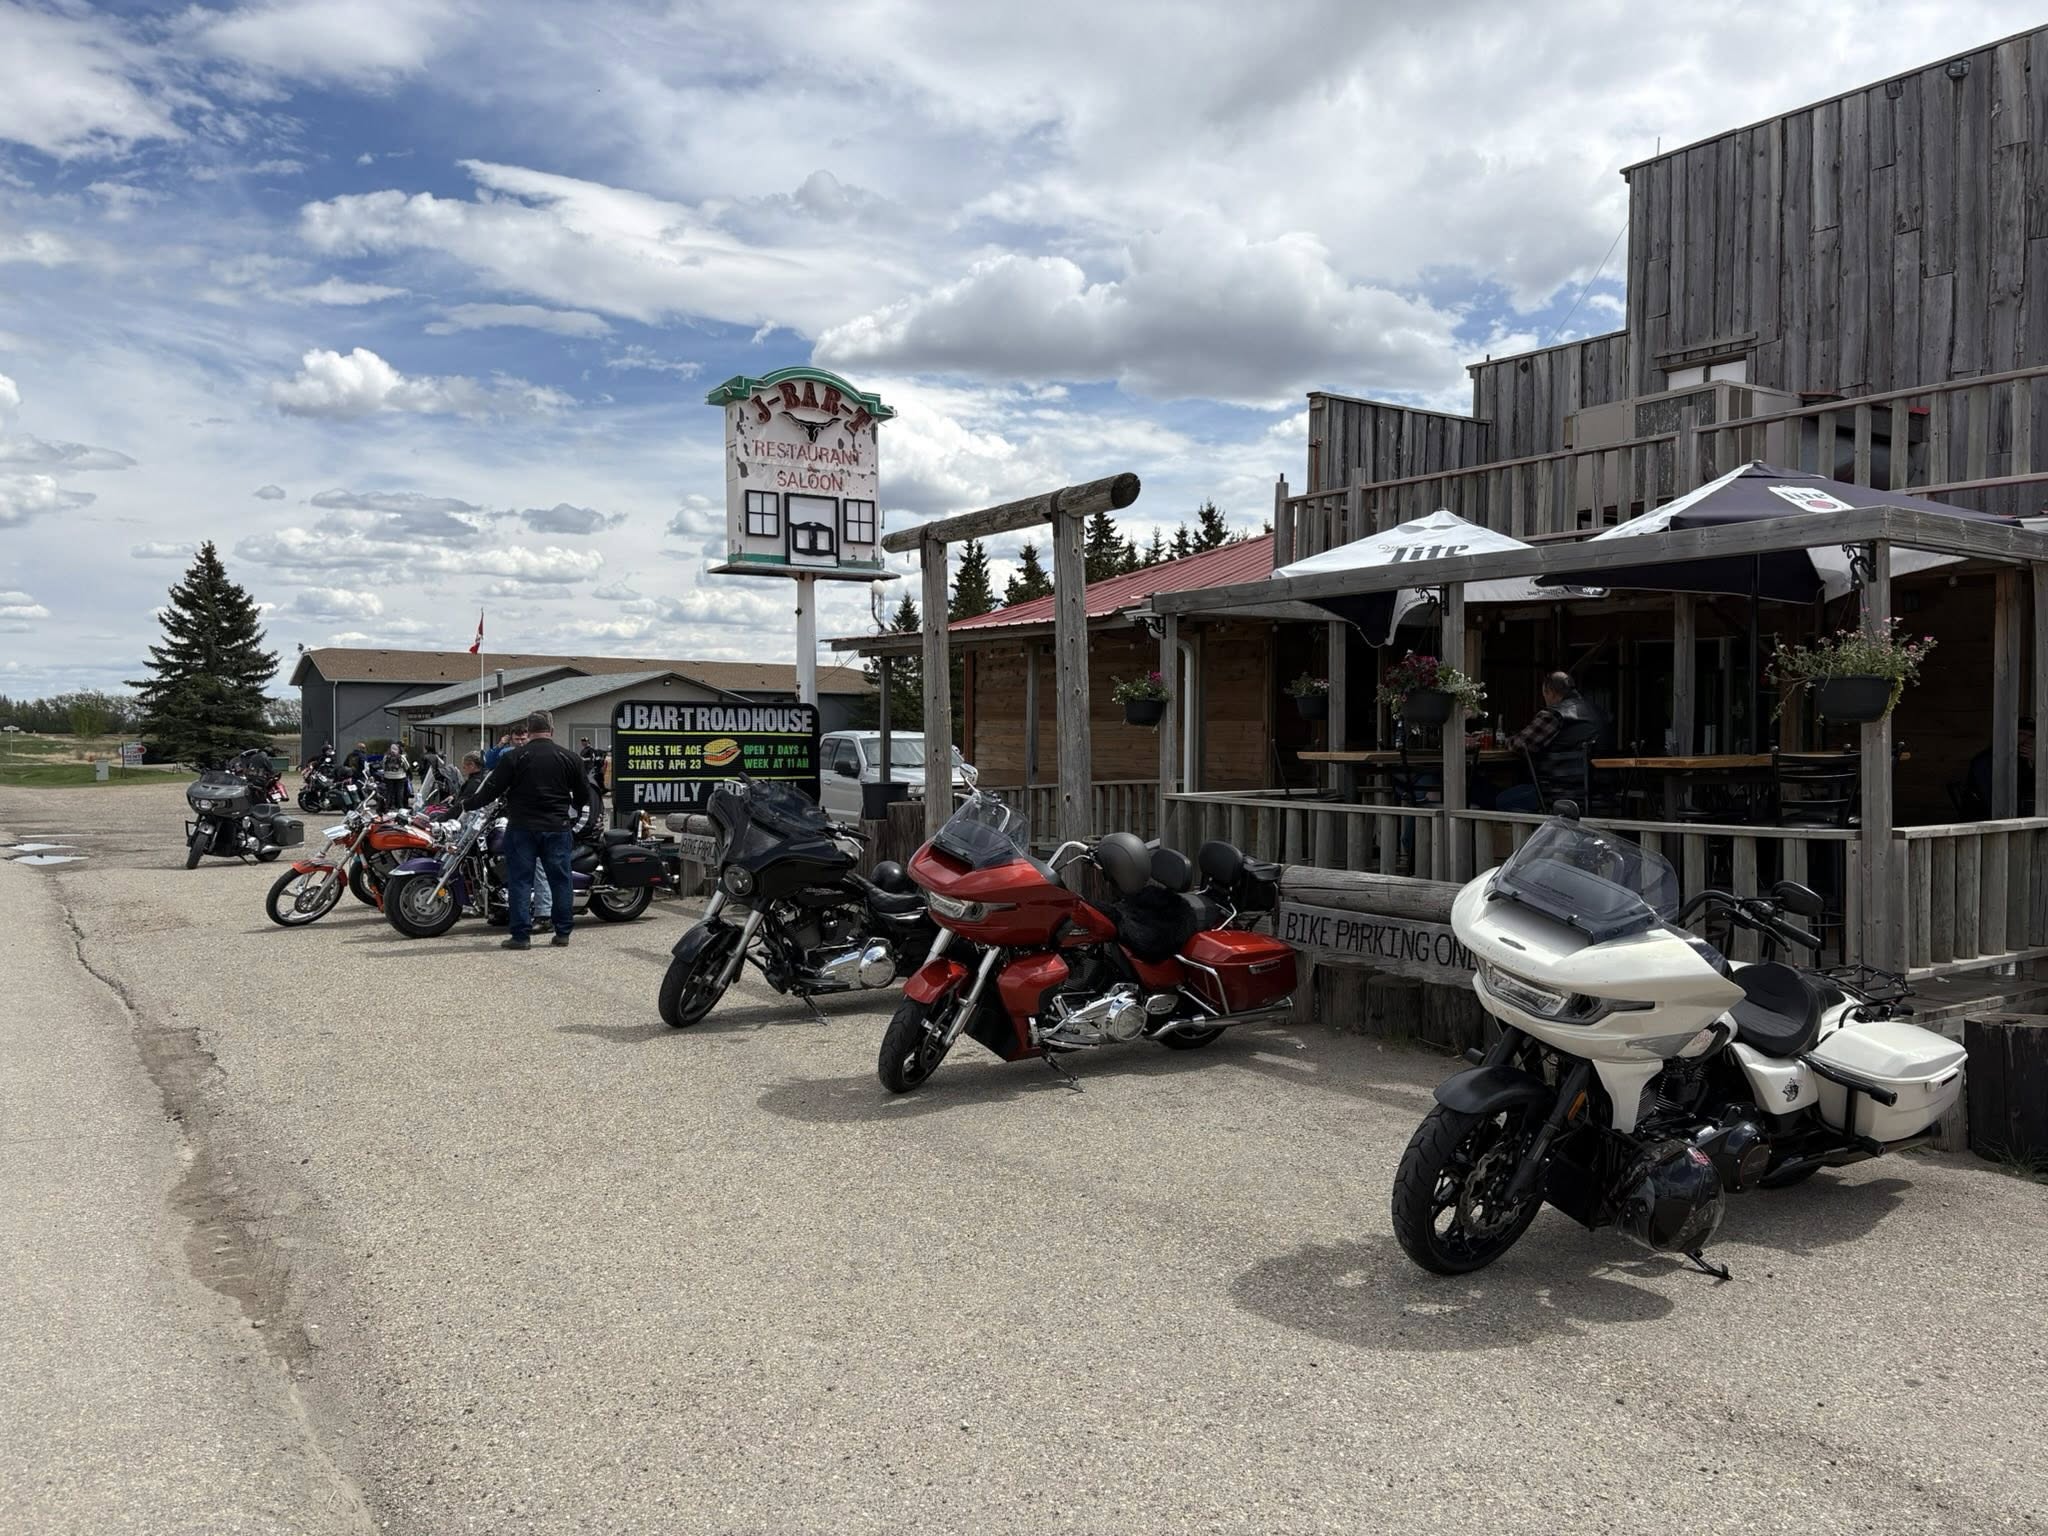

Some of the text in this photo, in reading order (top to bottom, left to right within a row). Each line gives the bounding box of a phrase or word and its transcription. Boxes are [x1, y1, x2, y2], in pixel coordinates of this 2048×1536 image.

[751, 382, 873, 432] J-BAR-T
[754, 440, 861, 466] RESTAURANT
[777, 470, 844, 491] SALOON
[696, 707, 813, 733] ROADHOUSE
[628, 745, 702, 756] CHASE THE ACE
[743, 745, 809, 755] OPEN 7 DAYS A
[628, 760, 702, 770] STARTS APR 23
[744, 759, 769, 769] WEEK
[773, 759, 784, 769] AT
[634, 783, 701, 803] FAMILY
[1286, 912, 1478, 971] BIKE PARKING ONL
